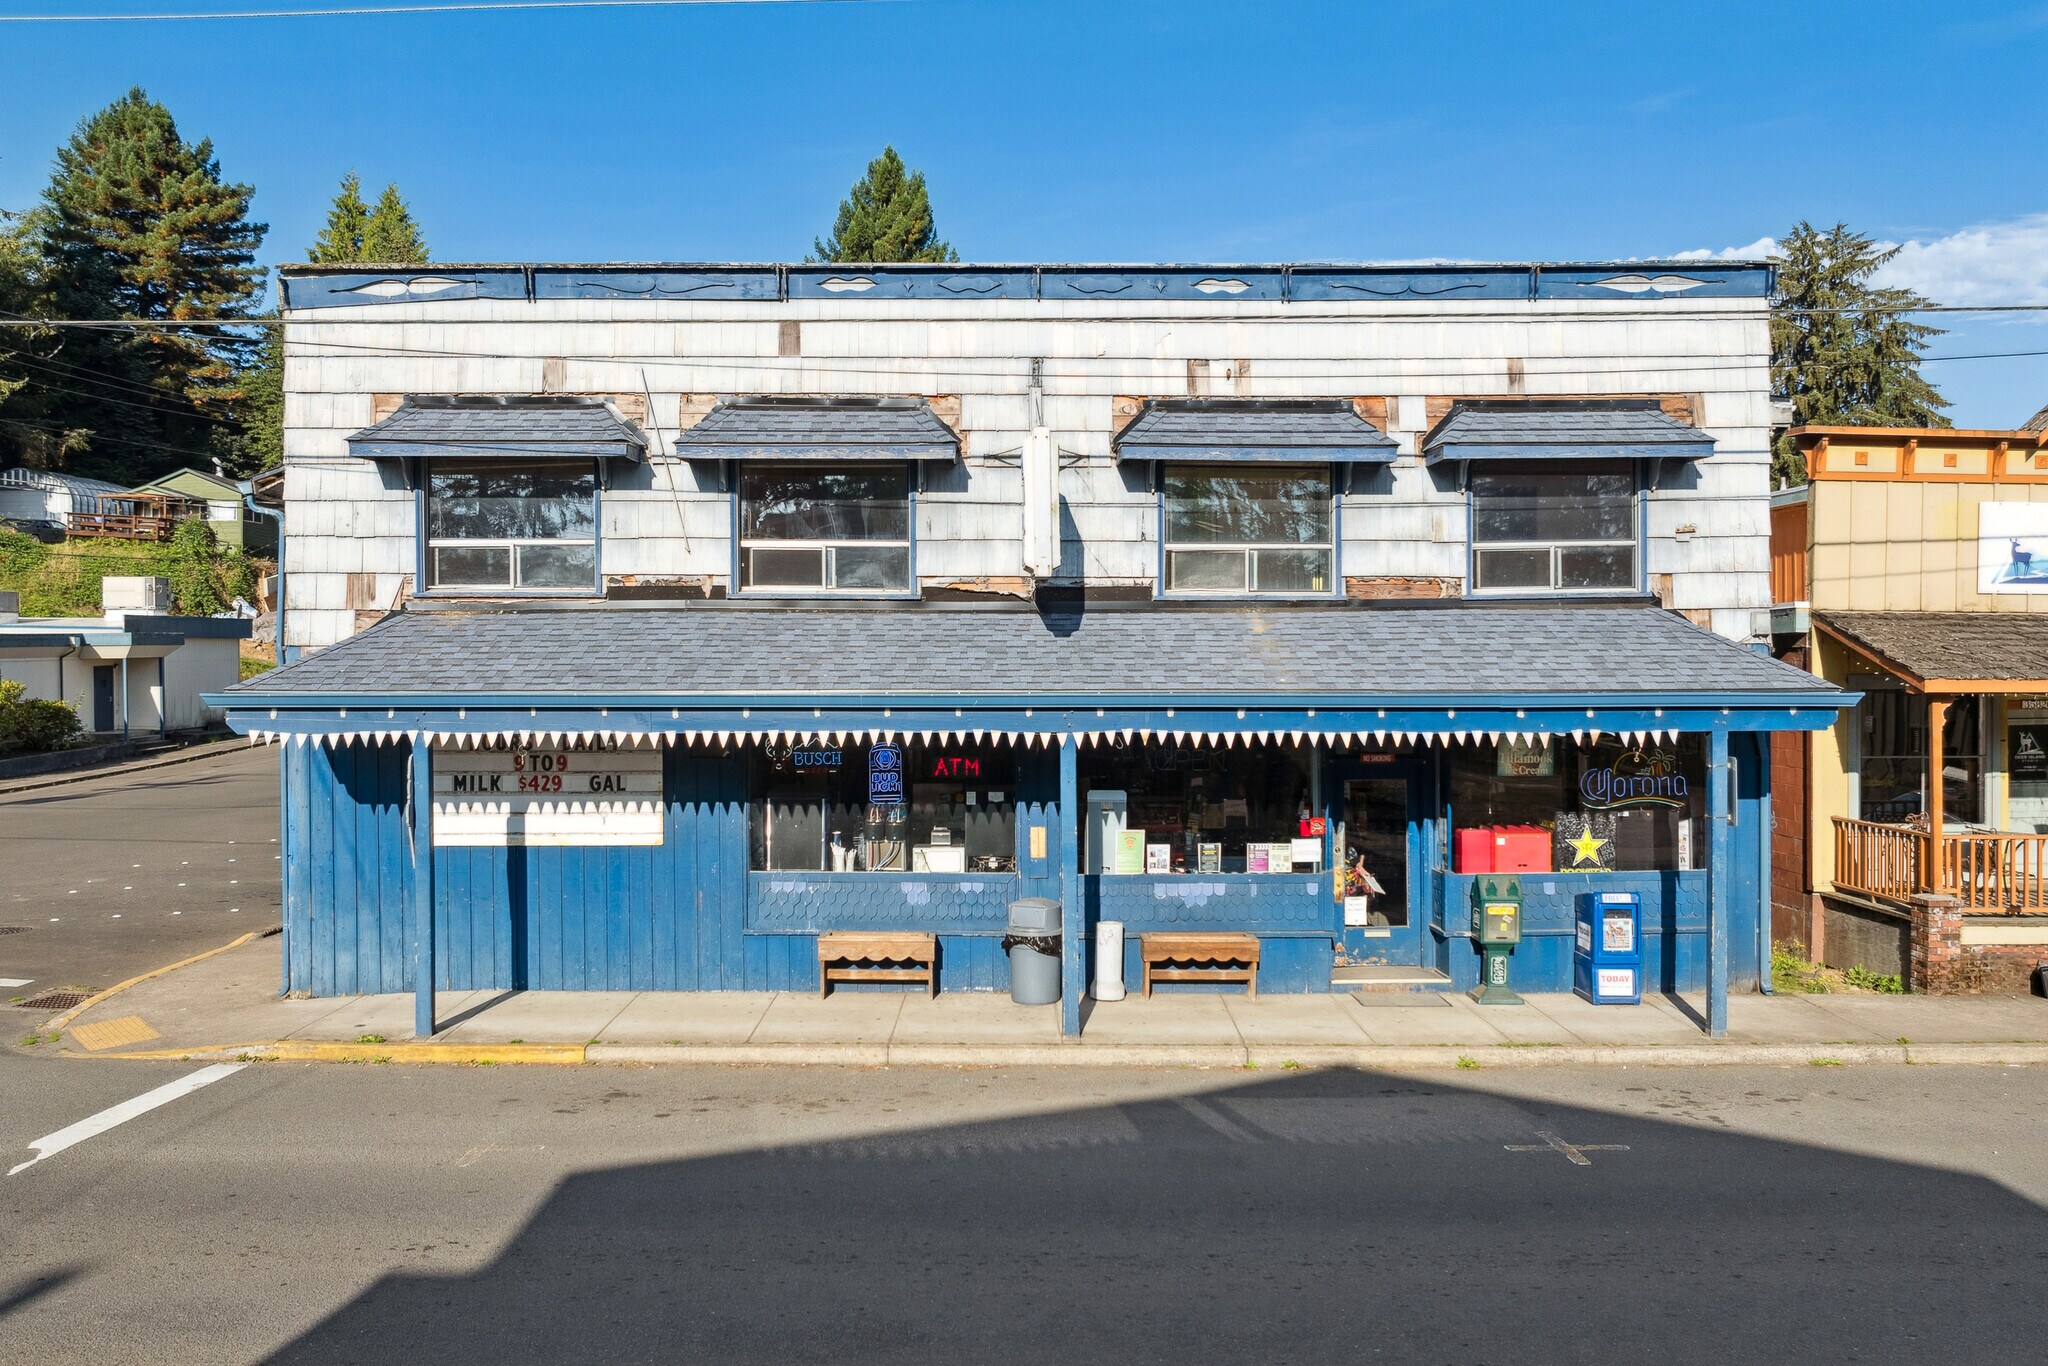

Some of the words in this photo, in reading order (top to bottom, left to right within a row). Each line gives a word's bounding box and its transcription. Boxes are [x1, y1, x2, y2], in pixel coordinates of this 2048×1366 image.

[514, 755, 525, 771] 9
[529, 755, 553, 771] TO
[556, 755, 568, 771] 9
[793, 751, 842, 766] BUSCH
[1500, 752, 1553, 764] Tillamook
[934, 758, 979, 777] ATM
[1505, 766, 1518, 775] Ice
[1519, 766, 1548, 775] Cream
[453, 775, 501, 791] MILK
[519, 775, 563, 792] $429
[590, 775, 626, 791] GAL
[871, 772, 898, 782] BUD
[1580, 768, 1688, 804] Corona
[1601, 975, 1630, 983] TODAY
